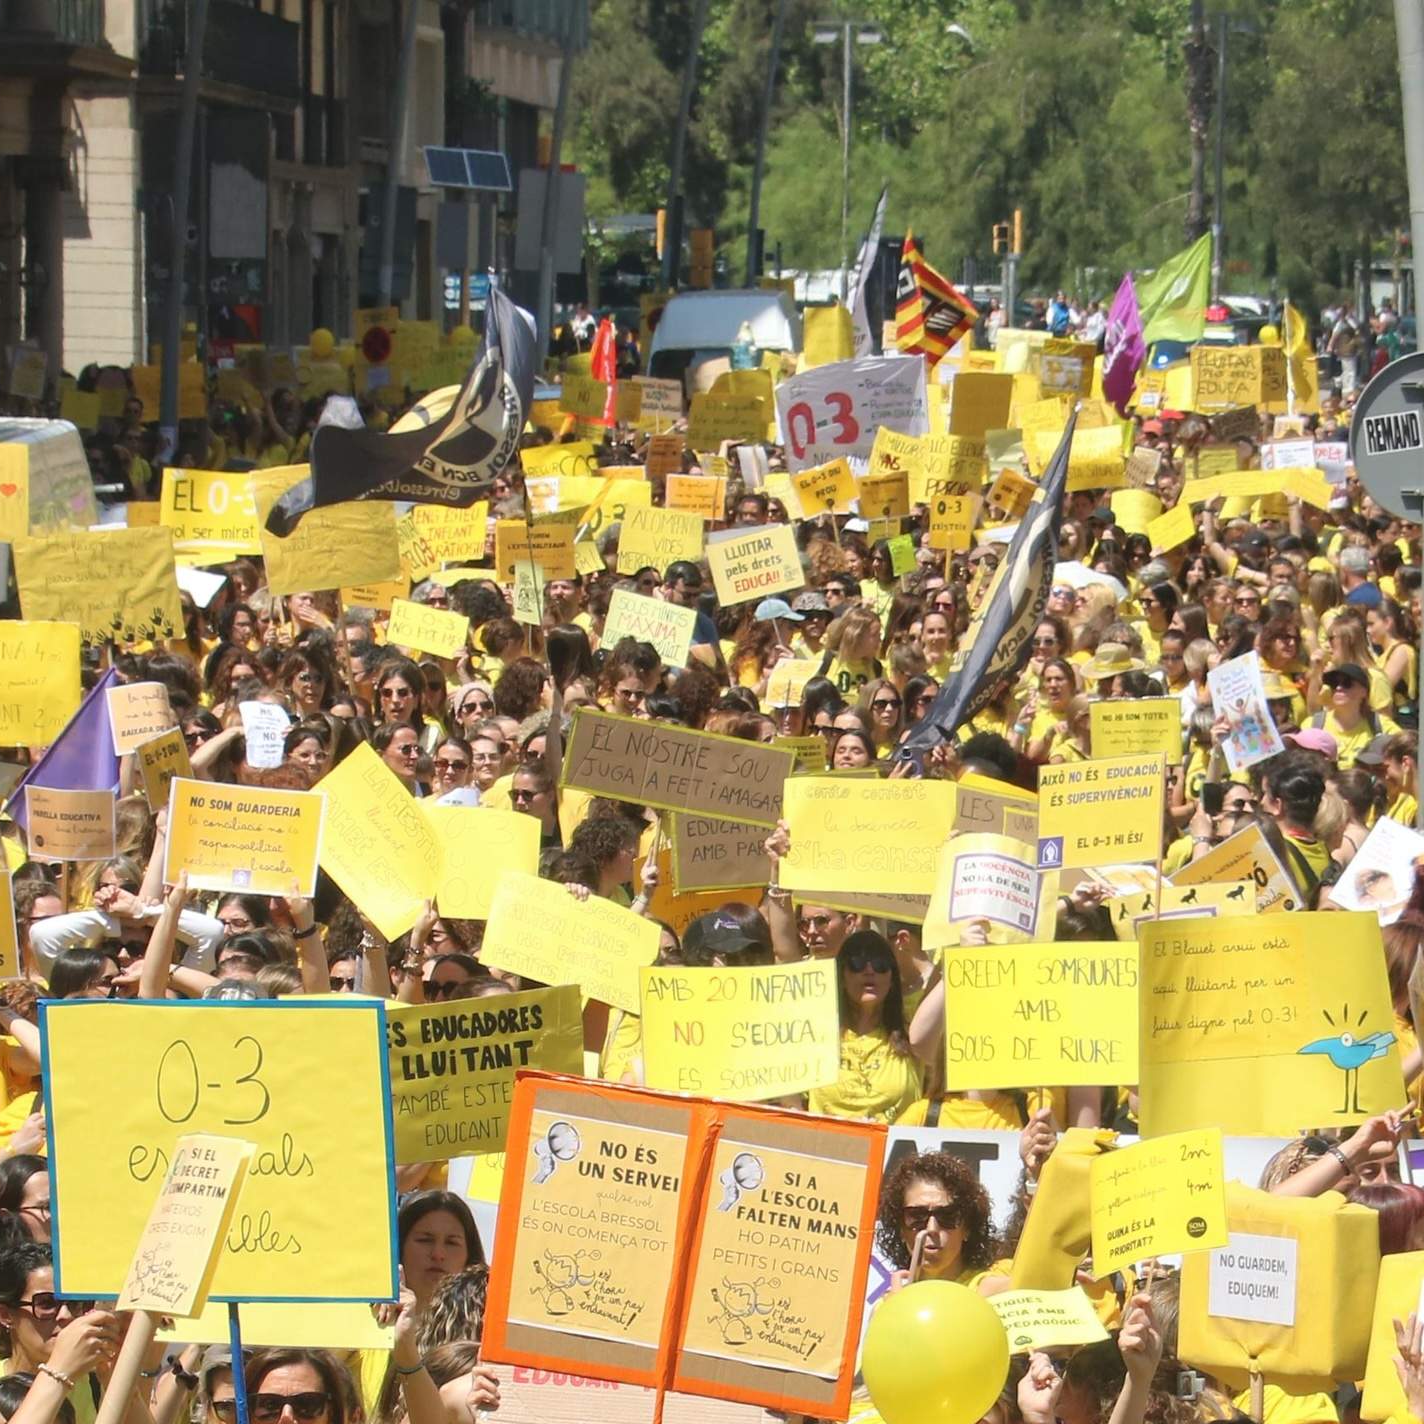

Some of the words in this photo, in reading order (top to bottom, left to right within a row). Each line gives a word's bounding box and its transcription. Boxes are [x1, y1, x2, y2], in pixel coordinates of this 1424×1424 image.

[787, 392, 859, 460] 0-3
[1366, 415, 1420, 452] REMAND
[937, 501, 962, 514] 0-3
[193, 527, 213, 538] ser
[221, 526, 254, 539] mirat
[725, 537, 773, 561] LLUITAR
[726, 564, 750, 580] pels
[752, 555, 782, 572] drets
[734, 572, 780, 593] EDUCA!!
[592, 723, 613, 751] EL
[626, 733, 710, 771] NOSTRE
[723, 756, 769, 782] SOU
[189, 795, 206, 808] NO
[209, 799, 233, 813] SOM
[235, 802, 302, 818] GUARDERIA
[960, 798, 994, 822] LES
[1051, 793, 1063, 807] ÉS
[1067, 787, 1153, 805] SUPERVIVÈNCIA!
[1077, 838, 1088, 849] EL
[1093, 838, 1110, 847] 0-3
[1114, 835, 1124, 845] HI
[1127, 833, 1143, 844] ÉS!
[692, 846, 727, 863] AMB
[646, 967, 693, 1002] AMB
[707, 975, 738, 1003] 20
[750, 968, 827, 1000] INFANTS
[948, 956, 1018, 990] CREEM
[1036, 957, 1137, 988] SOMRIURES
[420, 1003, 543, 1044] EDUCADORES
[1014, 998, 1060, 1023] AMB
[949, 1031, 997, 1064] SOUS
[1012, 1034, 1042, 1061] DE
[1059, 1034, 1123, 1064] RIURE
[156, 1035, 270, 1126] 0-3
[598, 1139, 628, 1160] NO
[634, 1141, 659, 1165] ÉS
[578, 1160, 606, 1181] UN
[611, 1163, 679, 1194] SERVEI
[783, 1171, 802, 1187] SI
[805, 1174, 818, 1190] A
[532, 1198, 596, 1223] L'ESCOLA
[599, 1211, 664, 1233] BRESSOL
[736, 1204, 803, 1234] FALTEN
[806, 1217, 859, 1241] MANS
[522, 1216, 541, 1231] ÉS
[544, 1220, 565, 1235] ON
[567, 1223, 632, 1250] COMENÇA
[635, 1236, 669, 1253] TOT
[738, 1229, 765, 1245] HO
[768, 1234, 821, 1255] PATIM
[712, 1246, 768, 1271] PETITS
[772, 1255, 778, 1272] I
[781, 1257, 840, 1283] GRANS
[1219, 1253, 1235, 1269] NO
[1237, 1253, 1289, 1276] GUARDEM,
[1227, 1280, 1280, 1300] EDUQUEM!
